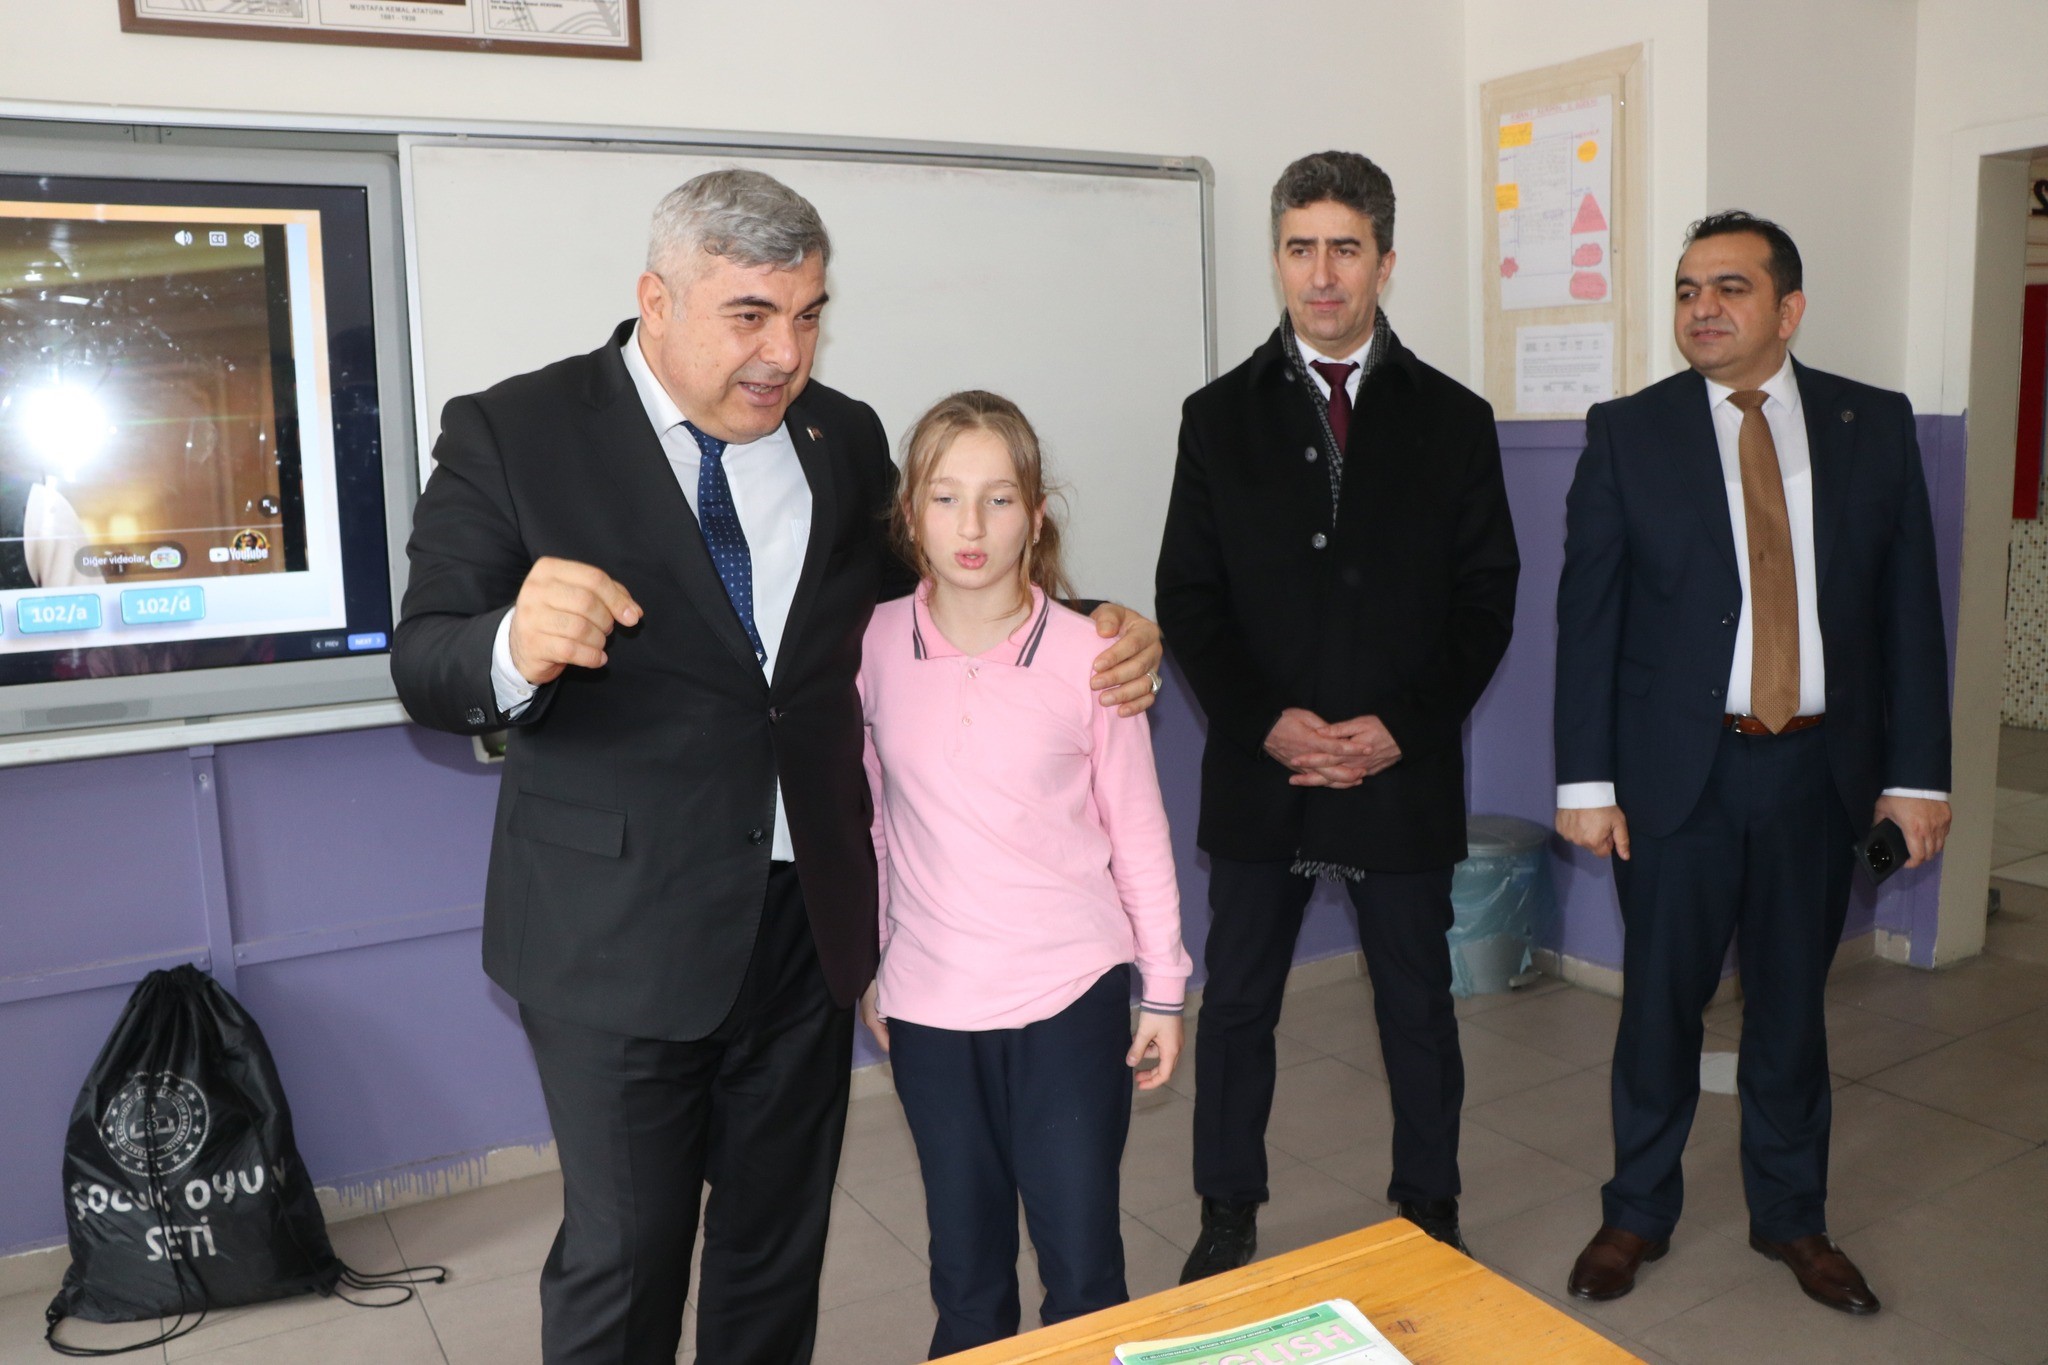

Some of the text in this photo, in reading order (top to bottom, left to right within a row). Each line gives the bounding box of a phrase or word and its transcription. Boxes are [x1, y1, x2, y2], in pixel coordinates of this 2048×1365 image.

[82, 557, 107, 567] Diğer
[229, 548, 269, 561] YouTube
[137, 596, 191, 615] 102/d
[31, 607, 88, 624] 102/a
